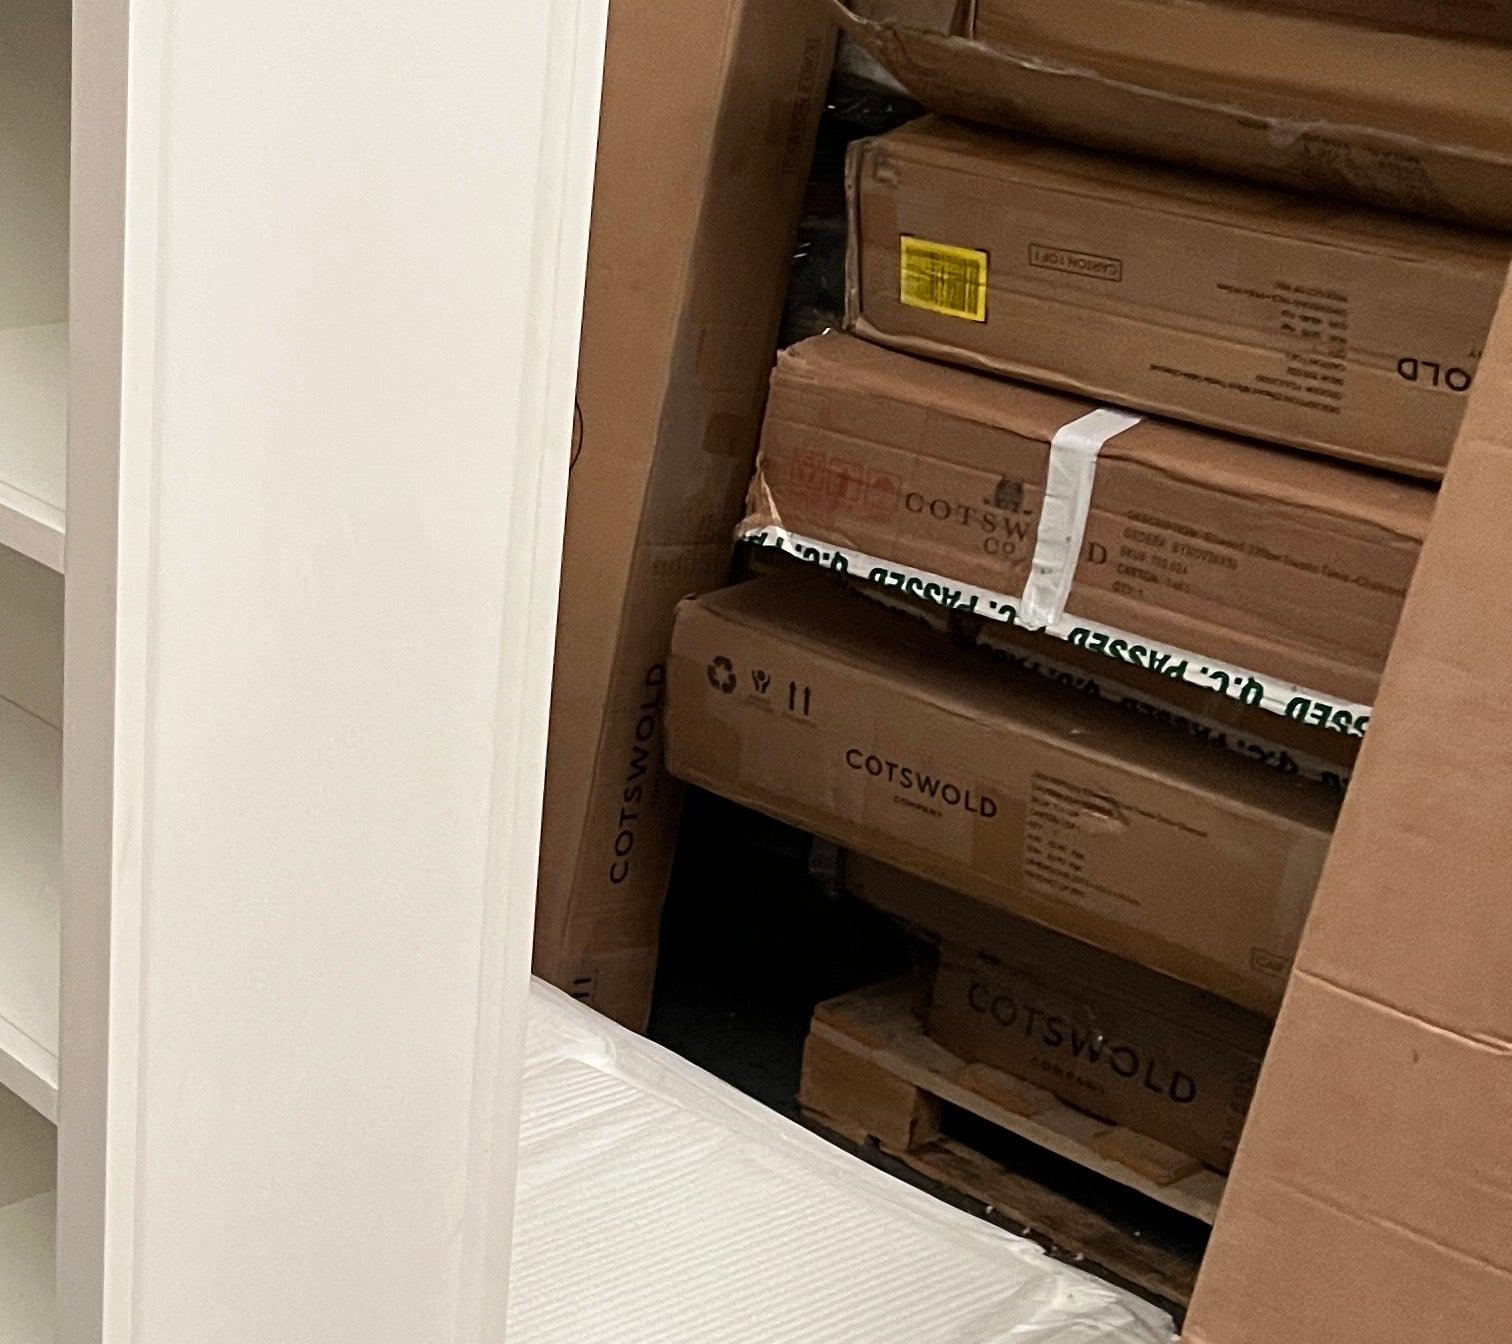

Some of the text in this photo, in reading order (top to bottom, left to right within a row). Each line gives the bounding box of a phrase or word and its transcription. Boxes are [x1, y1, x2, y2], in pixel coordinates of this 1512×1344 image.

[905, 492, 1108, 566] COTSWD
[867, 566, 980, 614] PASSED
[1066, 627, 1191, 681] PASSED
[1285, 695, 1371, 738] SSED
[610, 663, 666, 884] COTSWOLD
[845, 749, 998, 818] COTSWOLD
[968, 981, 1197, 1103] COTSWOLD
